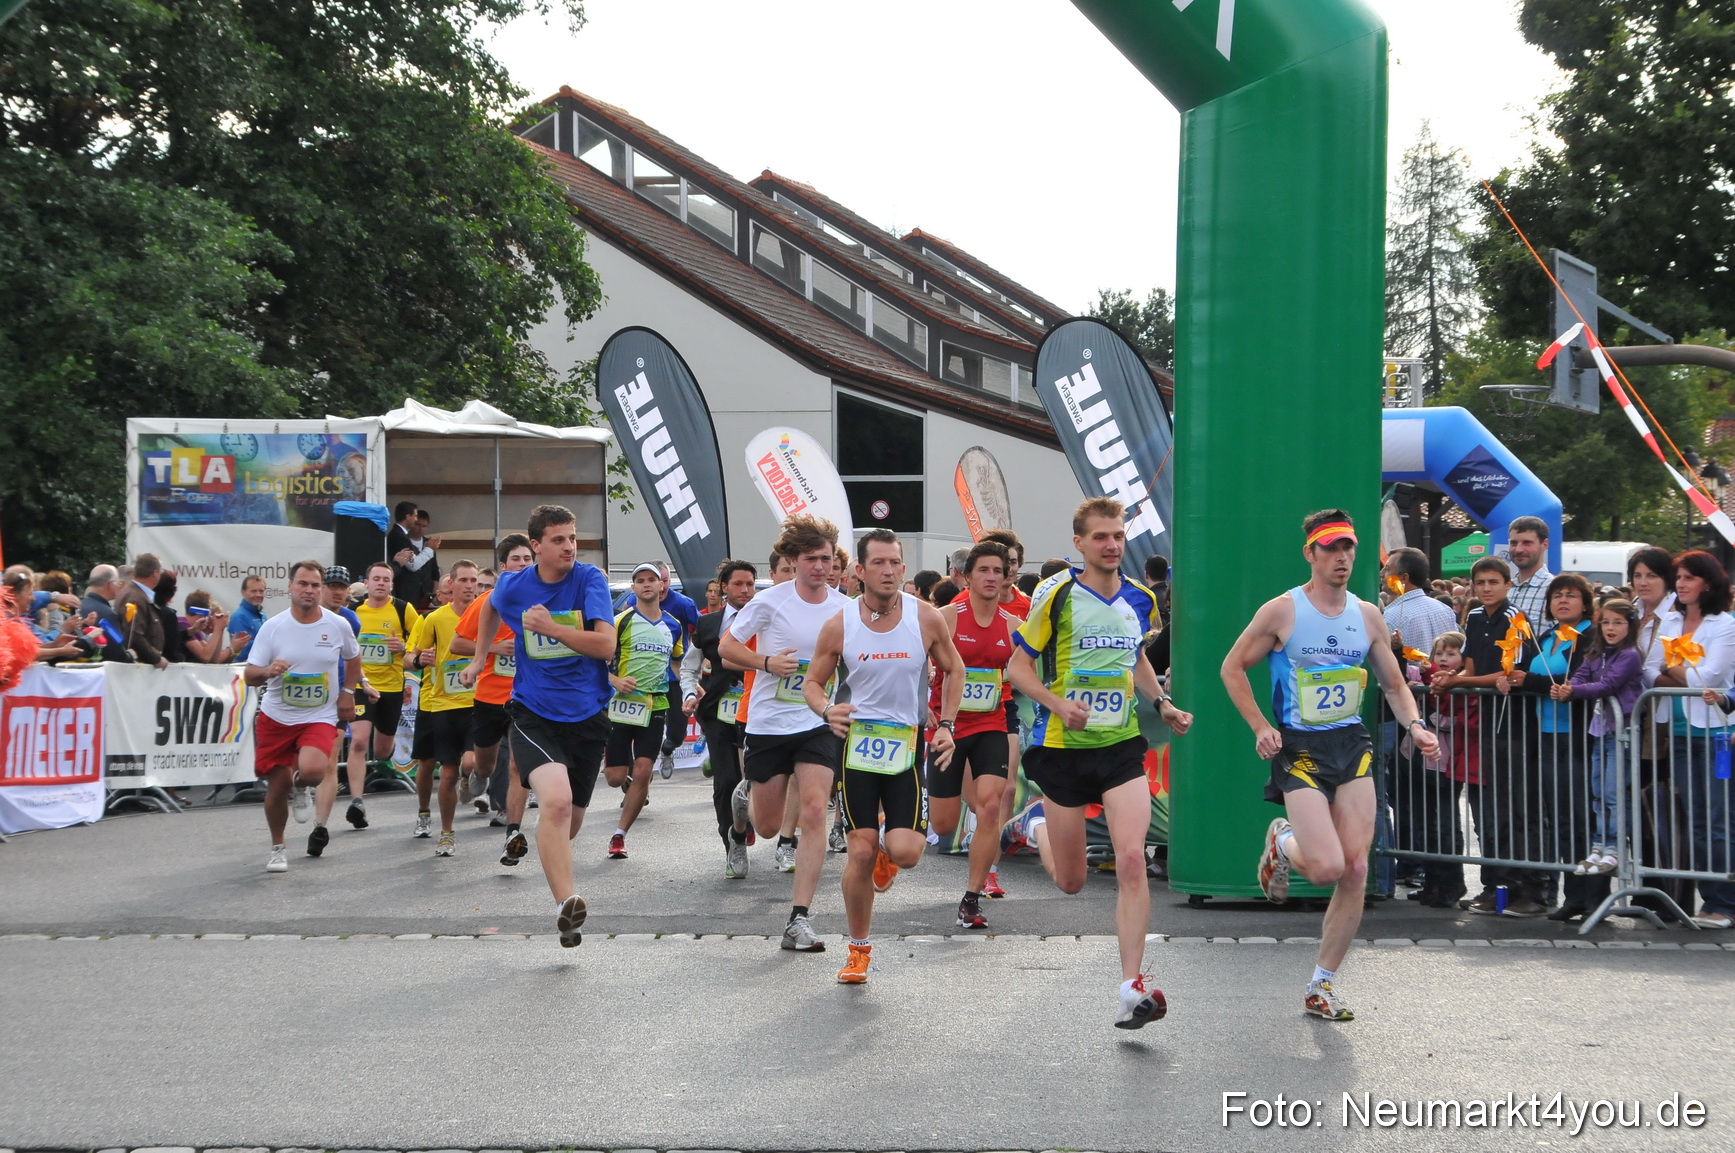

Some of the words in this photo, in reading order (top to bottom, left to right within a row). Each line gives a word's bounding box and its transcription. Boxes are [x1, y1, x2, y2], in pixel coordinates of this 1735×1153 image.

[147, 457, 231, 484] TLA
[244, 470, 343, 500] Logistics
[1082, 625, 1120, 634] TEAM
[360, 644, 385, 657] 779
[1080, 636, 1136, 649] BOCK
[872, 652, 911, 660] KLEBL
[1301, 647, 1362, 658] SCHABMÜLLER
[285, 685, 323, 698] 1215
[963, 683, 994, 699] 337
[1316, 684, 1346, 709] 23
[610, 699, 646, 716] 1057
[1066, 690, 1123, 712] 1059
[154, 695, 224, 746] swn
[4, 706, 96, 778] MEIER
[855, 737, 902, 761] 497
[199, 749, 240, 768] neumarkt
